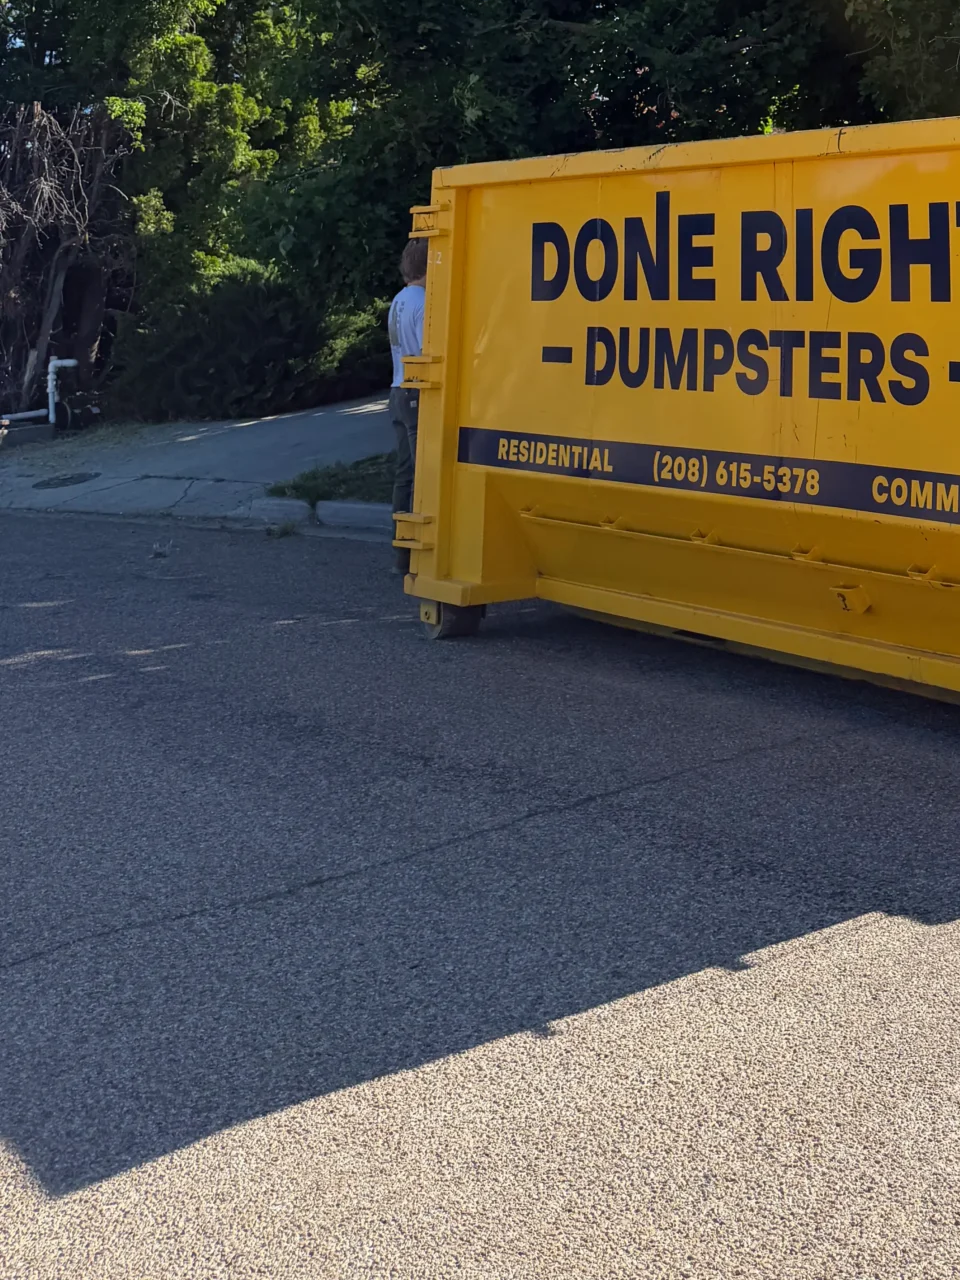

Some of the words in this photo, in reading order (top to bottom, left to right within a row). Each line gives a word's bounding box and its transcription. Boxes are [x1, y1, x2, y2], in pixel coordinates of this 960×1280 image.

[531, 190, 716, 302] DONE
[497, 438, 613, 473] RESIDENTIAL
[653, 451, 708, 487] (208)
[715, 460, 820, 497] 615-5378
